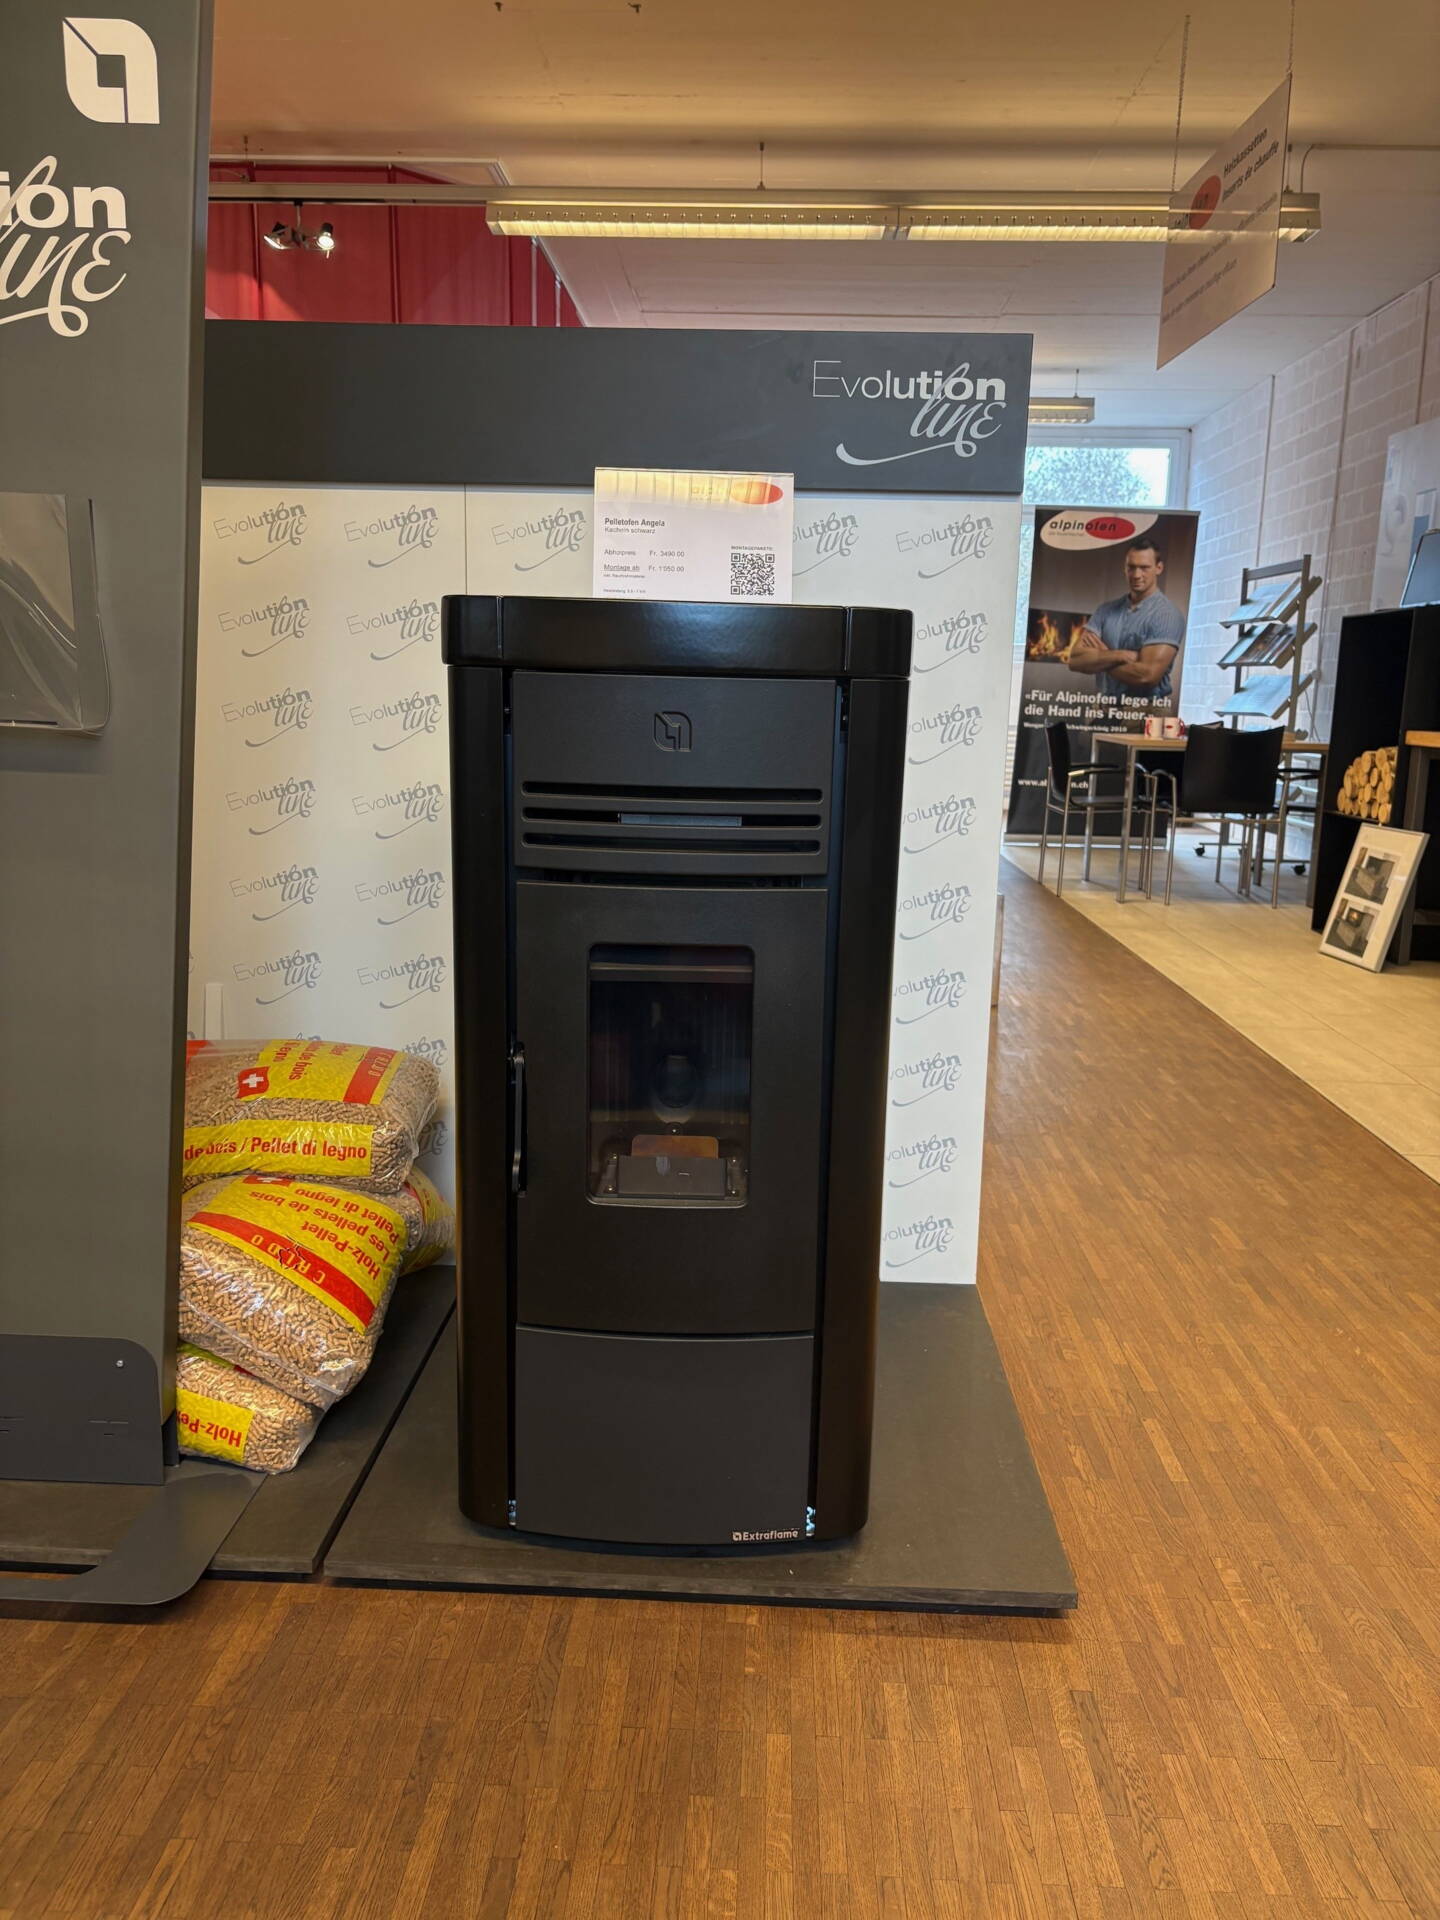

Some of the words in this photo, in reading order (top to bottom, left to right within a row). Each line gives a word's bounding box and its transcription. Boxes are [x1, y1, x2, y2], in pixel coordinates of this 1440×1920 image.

[813, 360, 1006, 401] Evolution
[640, 519, 665, 529] Angela
[793, 515, 858, 543] olution
[1049, 518, 1117, 532] alpinofen
[916, 612, 987, 641] olution
[1024, 703, 1043, 716] die
[1048, 705, 1081, 718] Hand
[1085, 707, 1104, 718] ins
[1056, 691, 1117, 705] Alpinofen
[1121, 694, 1149, 708] lege
[1152, 695, 1172, 708] ich
[911, 706, 981, 733] olution
[250, 1137, 298, 1154] Pellet
[301, 1140, 317, 1156] di
[322, 1141, 368, 1161] legno
[249, 1190, 287, 1207] bois
[288, 1200, 310, 1212] de
[295, 1188, 340, 1208] legno
[342, 1198, 360, 1213] di
[312, 1208, 368, 1236] pellets
[361, 1210, 399, 1244] Pellet
[301, 1220, 382, 1281] Holz-Pellet
[368, 1238, 392, 1263] Les
[176, 1411, 242, 1447] Holz-Pe
[742, 1529, 799, 1542] Extraflame
